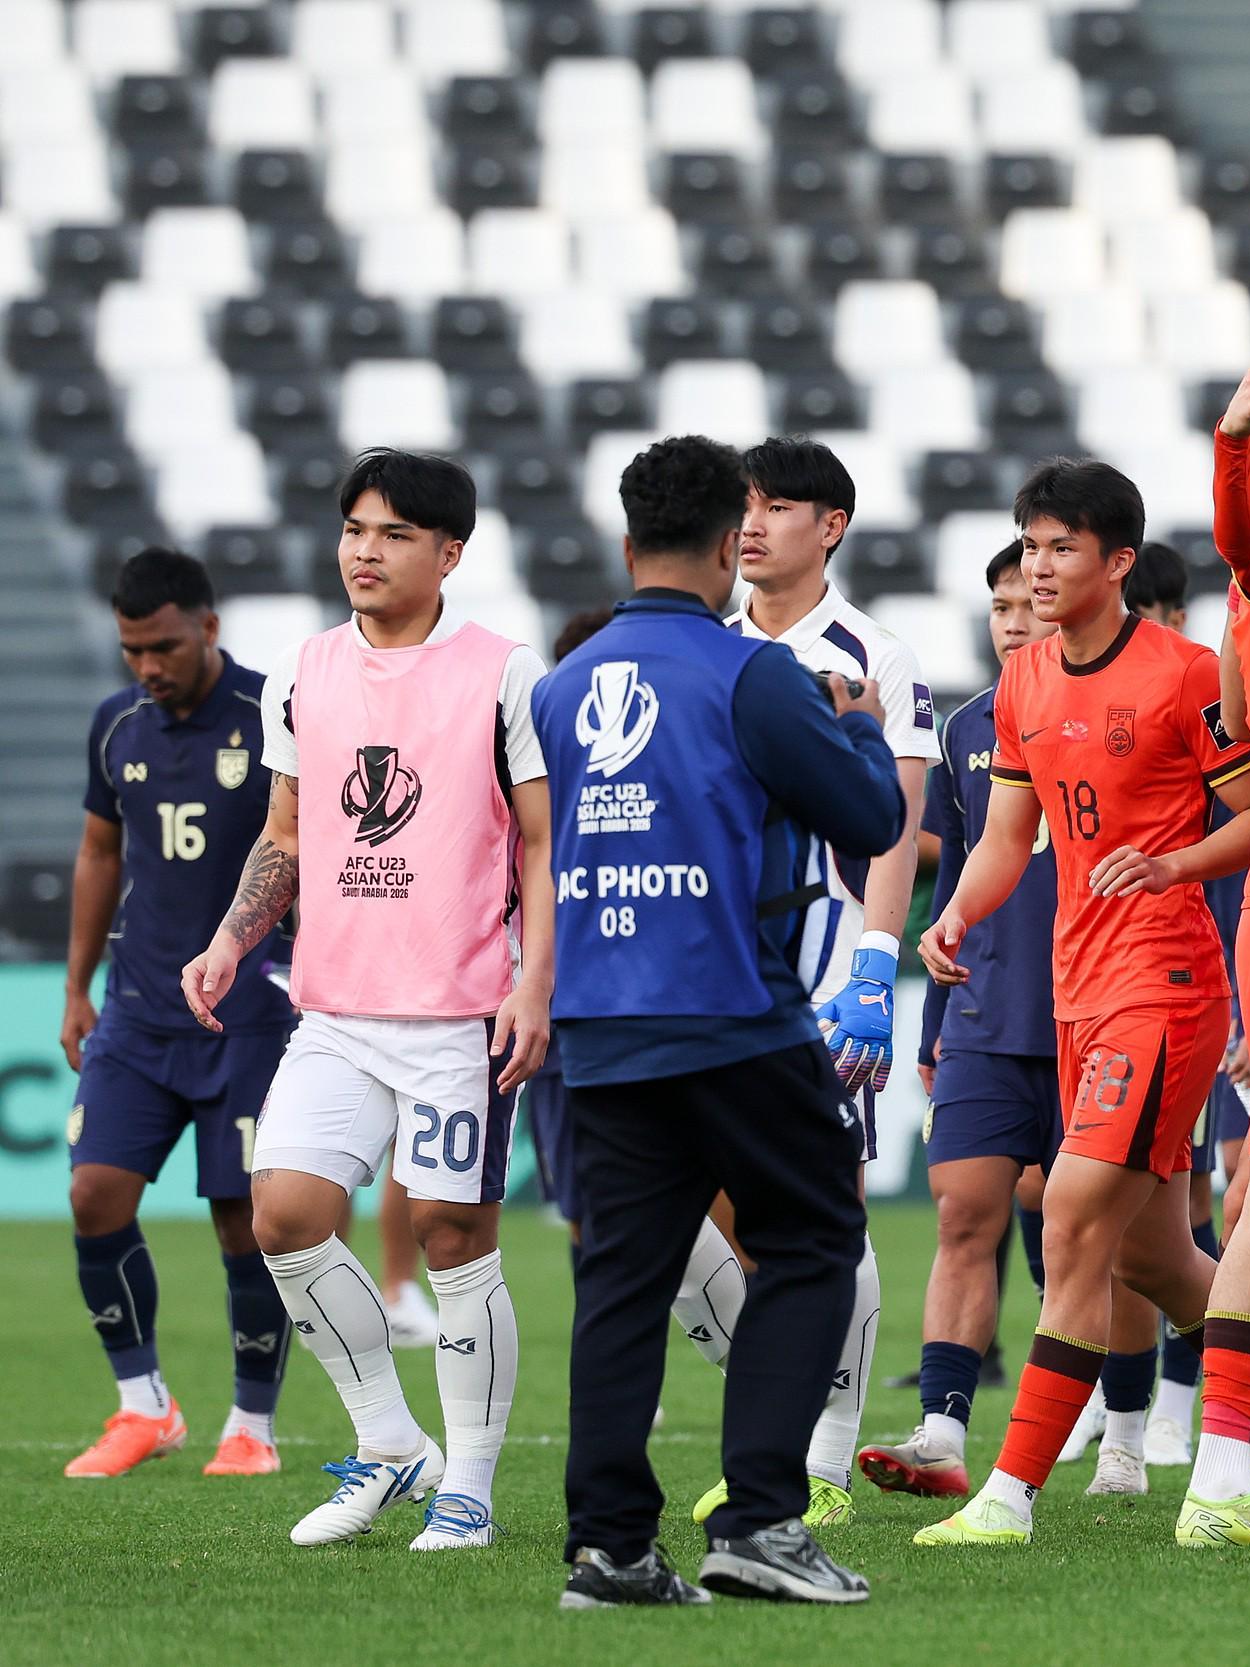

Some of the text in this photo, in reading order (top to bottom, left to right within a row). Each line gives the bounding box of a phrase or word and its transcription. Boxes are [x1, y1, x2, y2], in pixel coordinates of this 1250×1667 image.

[1110, 711, 1133, 721] CFA
[581, 782, 648, 804] AFC U23
[622, 799, 656, 818] CUP
[1057, 780, 1100, 840] 18
[156, 802, 207, 861] 16
[345, 856, 406, 870] AFC U23
[337, 872, 414, 886] ASIAN CUP
[557, 864, 709, 904] AC PHOTO
[361, 887, 388, 899] ARABIA
[390, 888, 409, 899] 2026
[600, 906, 636, 938] 08
[1080, 1051, 1135, 1112] 18
[411, 1103, 480, 1173] 20
